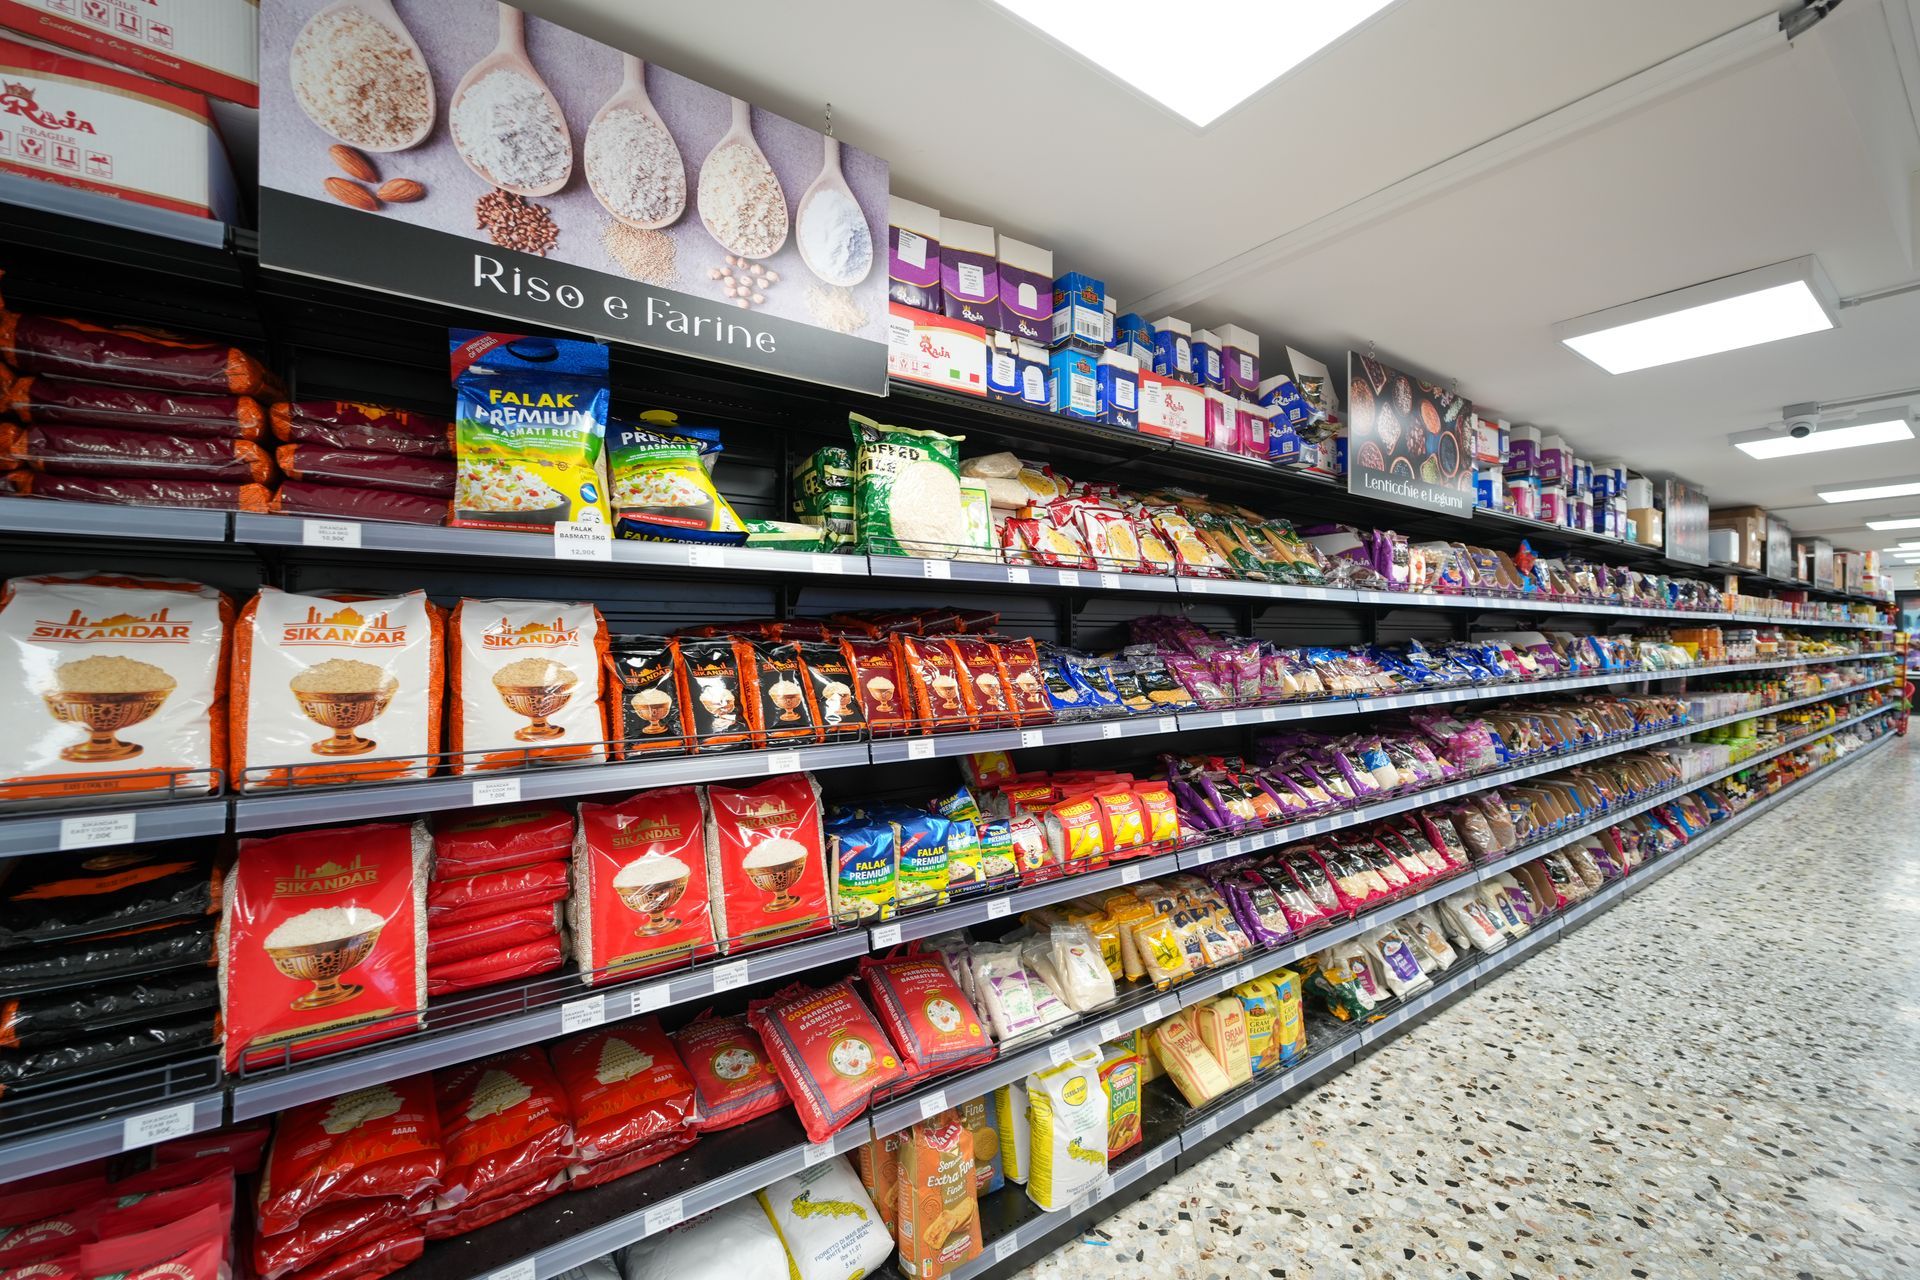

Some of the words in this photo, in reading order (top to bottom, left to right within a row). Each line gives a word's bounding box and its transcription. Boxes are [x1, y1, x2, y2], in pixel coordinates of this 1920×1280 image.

[21, 125, 76, 145] FRAGILE
[474, 254, 584, 309] Riso
[603, 295, 628, 321] e
[647, 296, 776, 353] Farine
[489, 389, 574, 408] FALAK
[475, 404, 593, 428] PREMIUM
[492, 427, 546, 439] BASMATI
[552, 429, 578, 439] RICE
[640, 443, 687, 452] BASMATI
[1364, 473, 1419, 499] Lenticchie
[1421, 489, 1428, 501] e
[1429, 488, 1463, 509] Legumi
[560, 532, 590, 541] BASMATI
[33, 625, 190, 639] SIKANDAR
[283, 628, 407, 643] SIKANDAR
[483, 632, 579, 648] SIKANDAR
[626, 667, 672, 686] SIKANDAR
[693, 668, 734, 678] SIKANDAR
[1059, 802, 1094, 816] GUARD
[739, 812, 798, 829] SIKANDAR
[612, 828, 681, 847] SIKANDAR
[948, 832, 967, 840] ALAK
[918, 847, 944, 857] FALAK
[856, 859, 886, 871] FALAK
[911, 854, 947, 866] PREMIUM
[850, 866, 891, 881] PREMIUM
[274, 870, 377, 893] SIKANDAR
[900, 973, 931, 983] BASMATI
[787, 1001, 824, 1022] GOLDEN
[799, 1010, 835, 1031] BASMATI
[834, 1002, 852, 1014] RICE
[801, 999, 844, 1022] PARBOILED
[1250, 1020, 1270, 1028] GRAM
[1250, 1026, 1271, 1034] FLOUR
[1224, 1026, 1243, 1041] GRAM
[654, 1073, 674, 1083] AAAAA
[797, 1078, 817, 1104] BASMATI
[812, 1102, 823, 1119] RICE
[528, 1107, 550, 1122] AAAAA
[965, 1103, 984, 1118] Fine
[392, 1126, 417, 1135] AAAAA
[927, 1172, 960, 1187] Extra
[959, 1158, 975, 1177] Fine
[814, 1241, 840, 1262] FIORETTO
[825, 1248, 842, 1262] WHITE
[854, 1229, 870, 1243] MEAL
